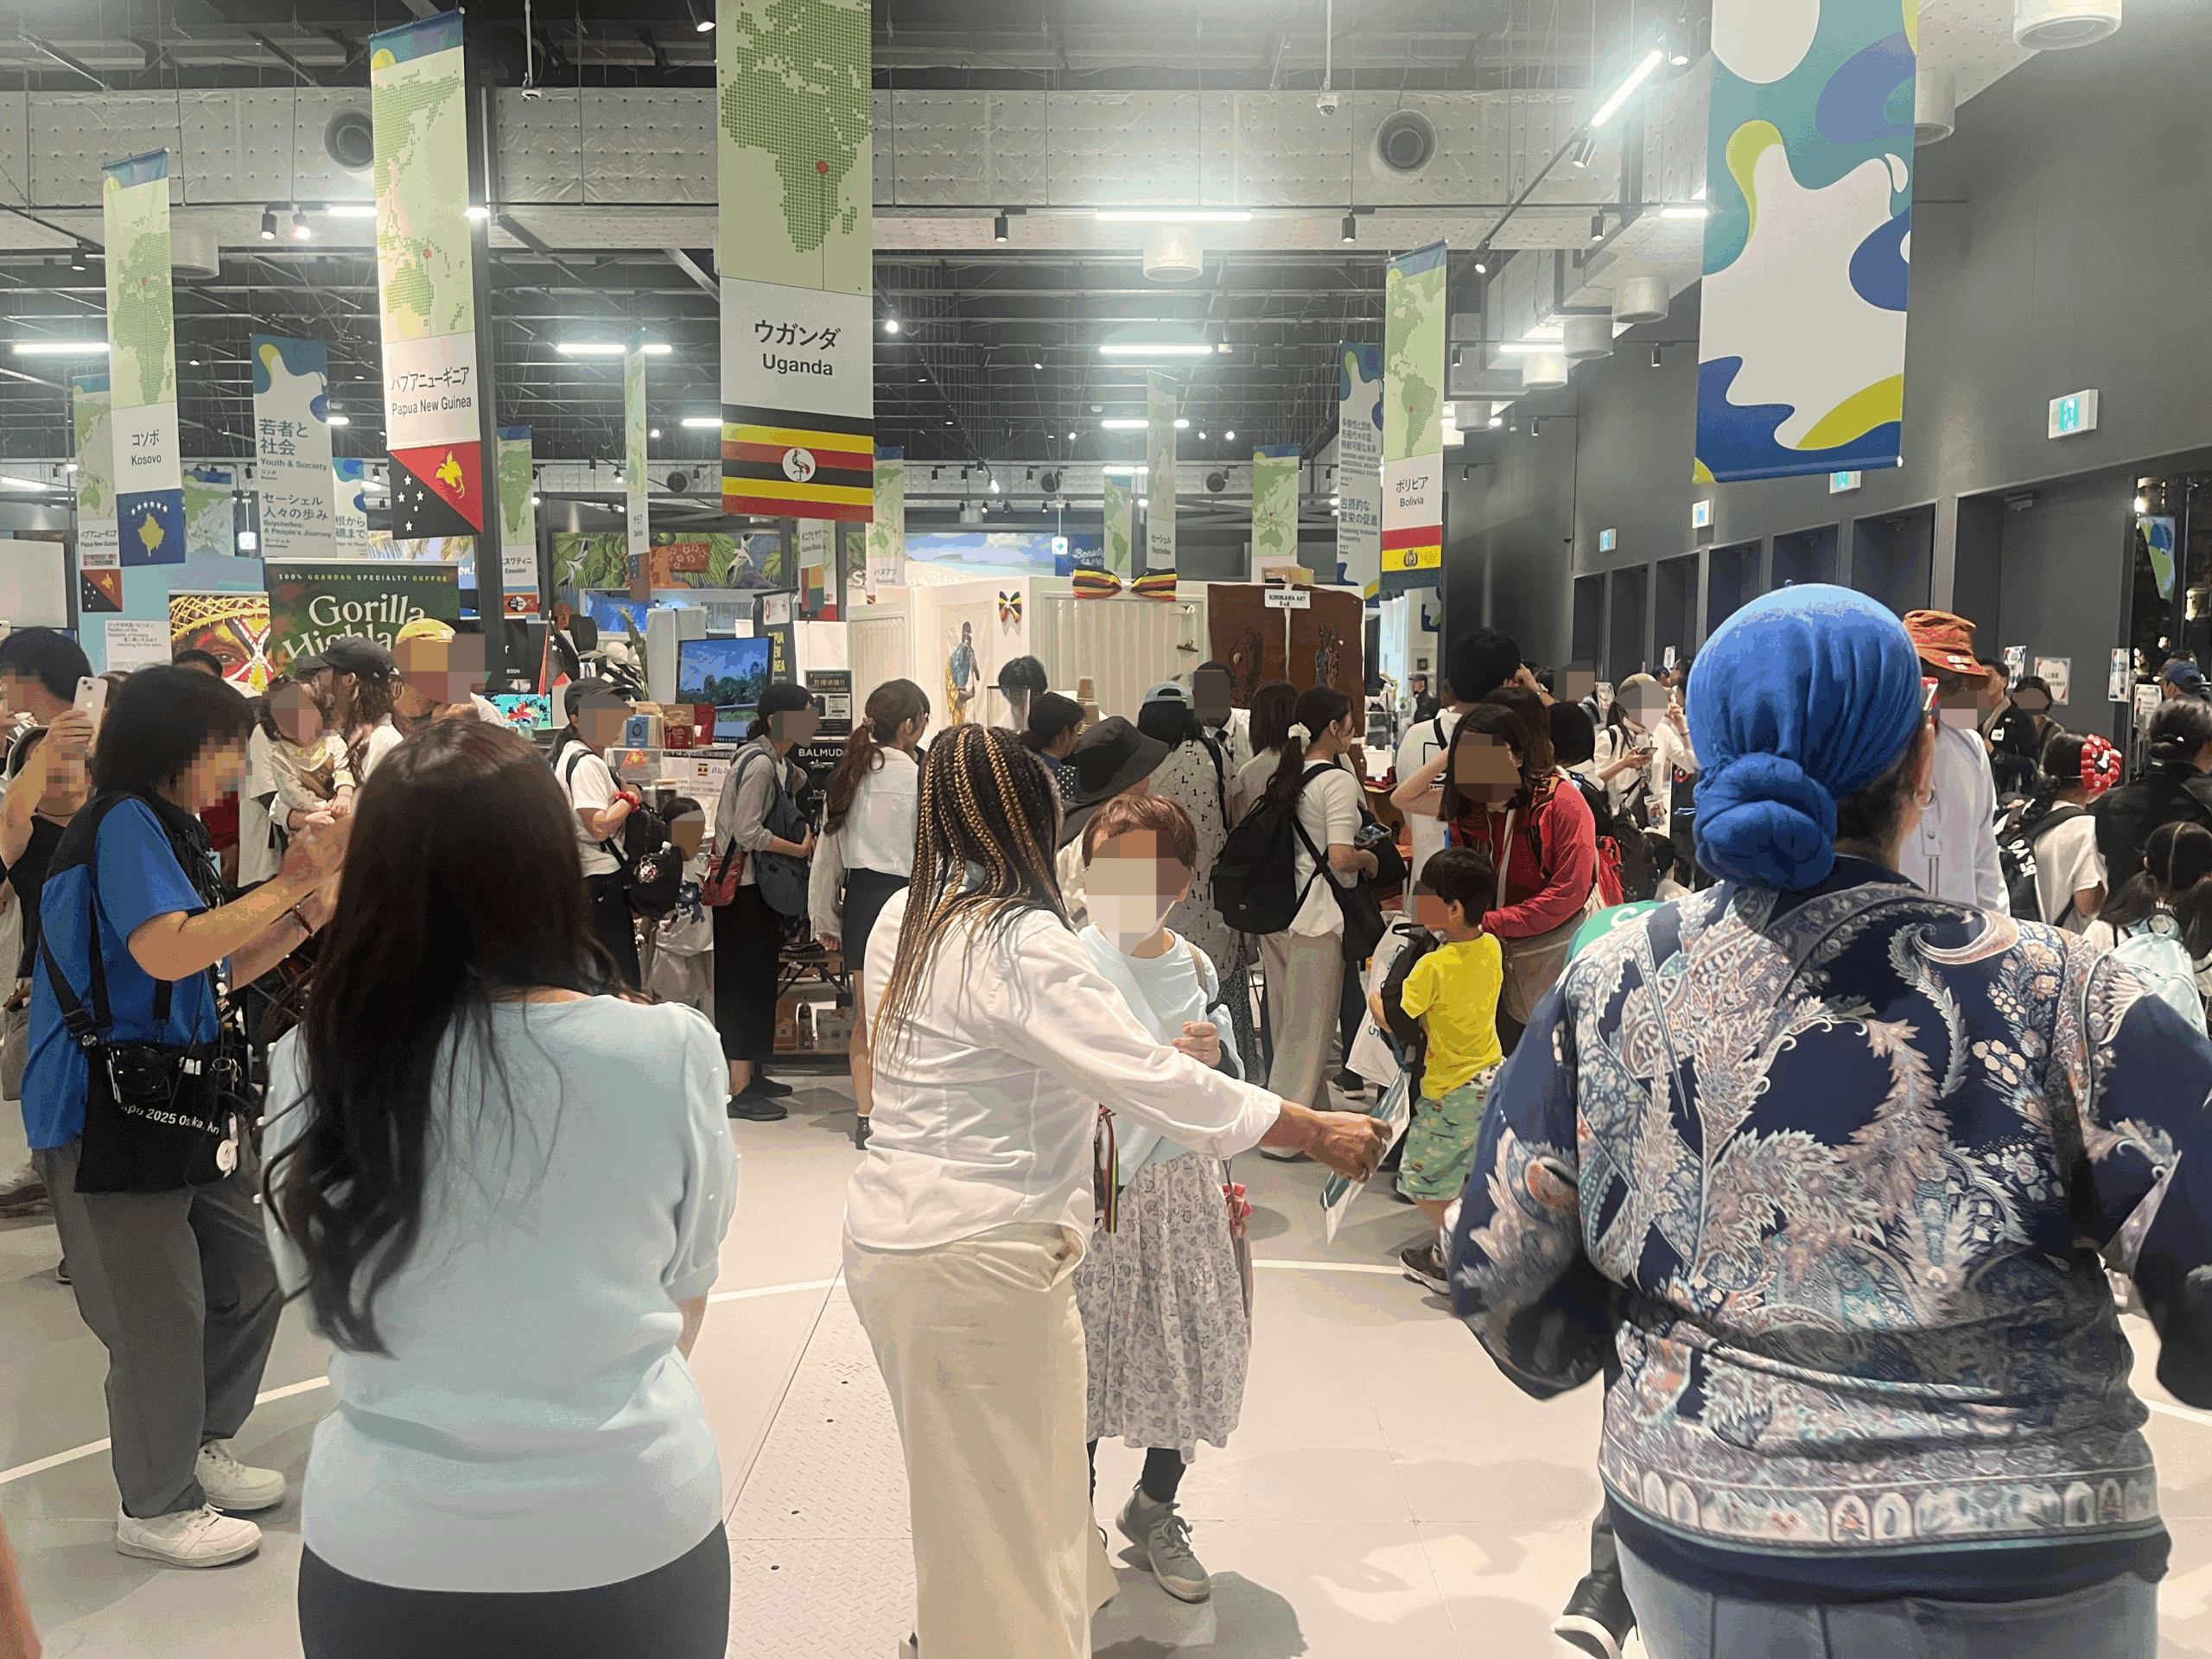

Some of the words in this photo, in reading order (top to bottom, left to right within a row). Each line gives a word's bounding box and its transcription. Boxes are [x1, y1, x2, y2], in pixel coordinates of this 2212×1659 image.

[754, 320, 842, 350] ウガンダ
[763, 353, 834, 375] Uganda
[391, 366, 470, 392] パプアニューギニア
[392, 403, 418, 417] Papua
[420, 399, 439, 412] New
[442, 396, 472, 410] Guinea
[259, 418, 308, 438] 若者と
[132, 429, 160, 447] コソボ
[260, 437, 296, 456] 社会
[131, 454, 162, 466] Kosovo
[260, 458, 285, 467] Youth
[296, 461, 327, 472] Society
[1395, 476, 1428, 493] ボリビア
[263, 493, 323, 505] セーシェル
[1400, 495, 1424, 507] Bolivia
[264, 505, 328, 521] 人々の歩み
[336, 515, 365, 527] 根から
[308, 594, 425, 626] Gorilla
[798, 748, 844, 757] BALMUD
[145, 1108, 177, 1124] 2025
